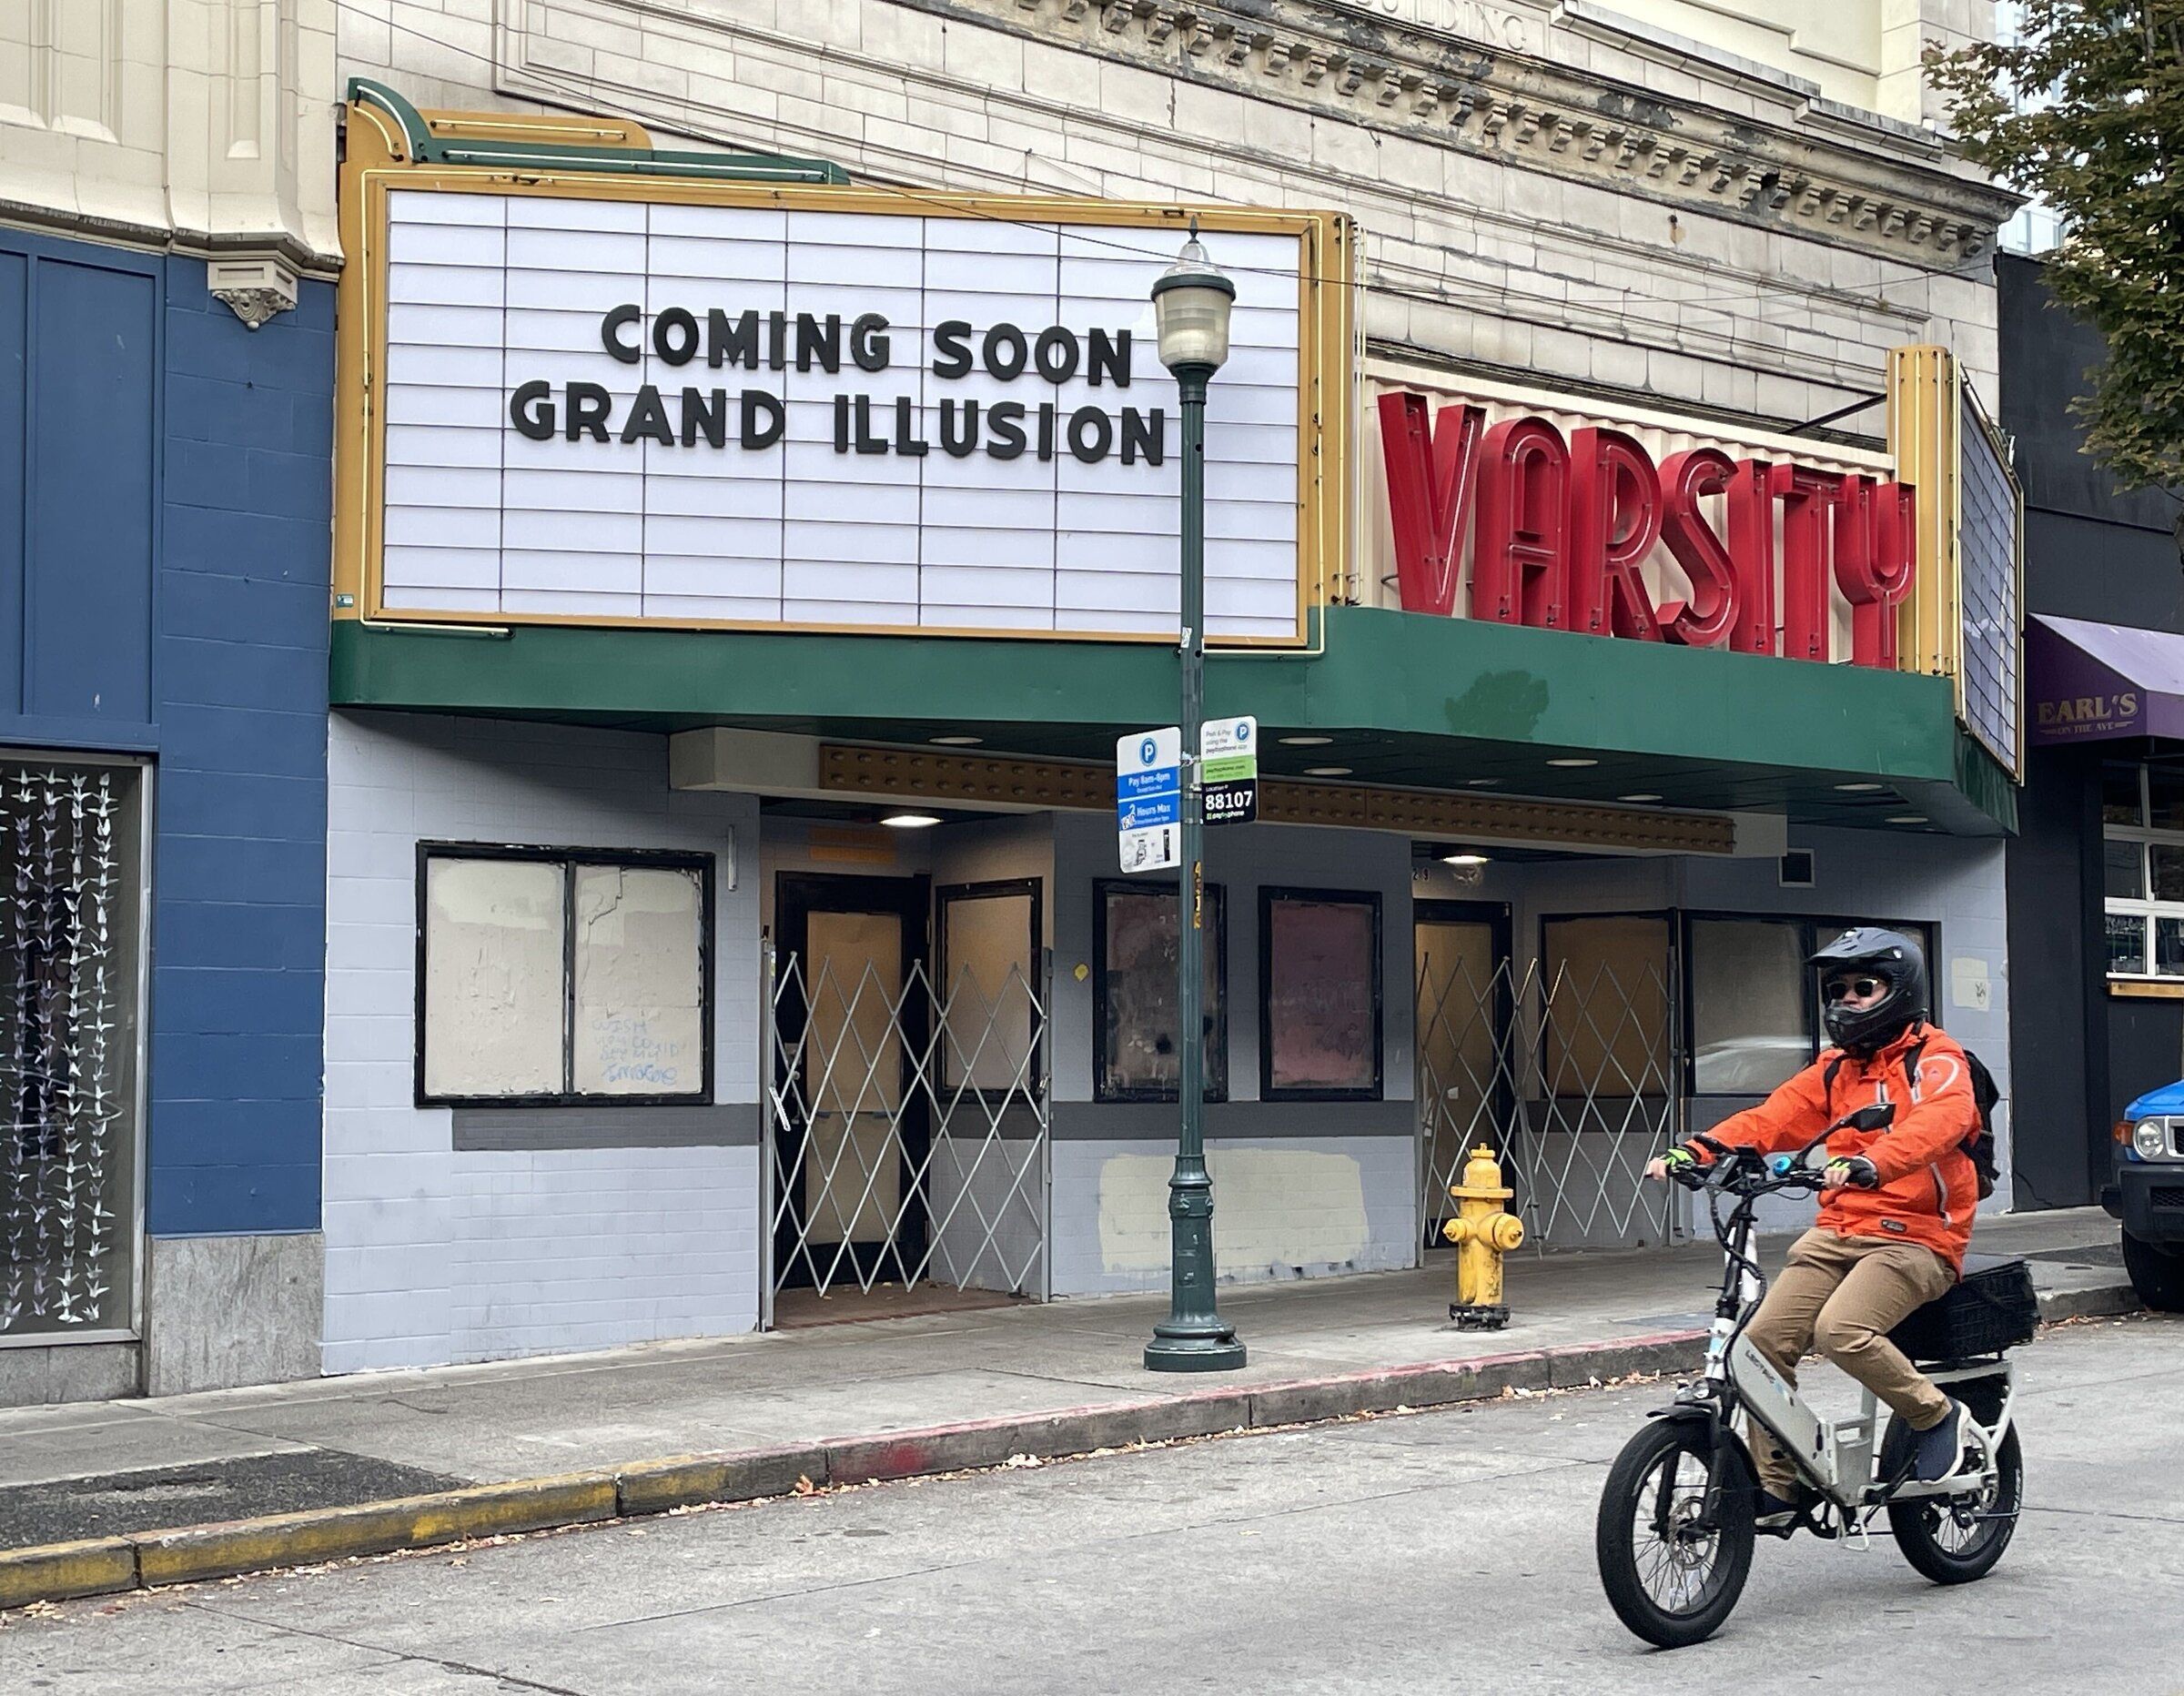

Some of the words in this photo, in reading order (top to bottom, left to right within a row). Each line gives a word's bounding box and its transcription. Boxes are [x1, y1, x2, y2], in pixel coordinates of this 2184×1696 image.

[602, 304, 890, 373] COMING
[933, 319, 1132, 389] SOON
[510, 380, 785, 450] GRAND
[834, 394, 1165, 467] ILLUSION
[1378, 391, 1916, 670] VARSITY
[2037, 692, 2138, 724] EARL'S
[2074, 724, 2091, 734] THE
[2096, 722, 2114, 731] AVE
[1128, 777, 1139, 788] Pay
[1137, 806, 1156, 817] Hours
[1157, 803, 1171, 814] Max
[1206, 790, 1253, 811] 88107
